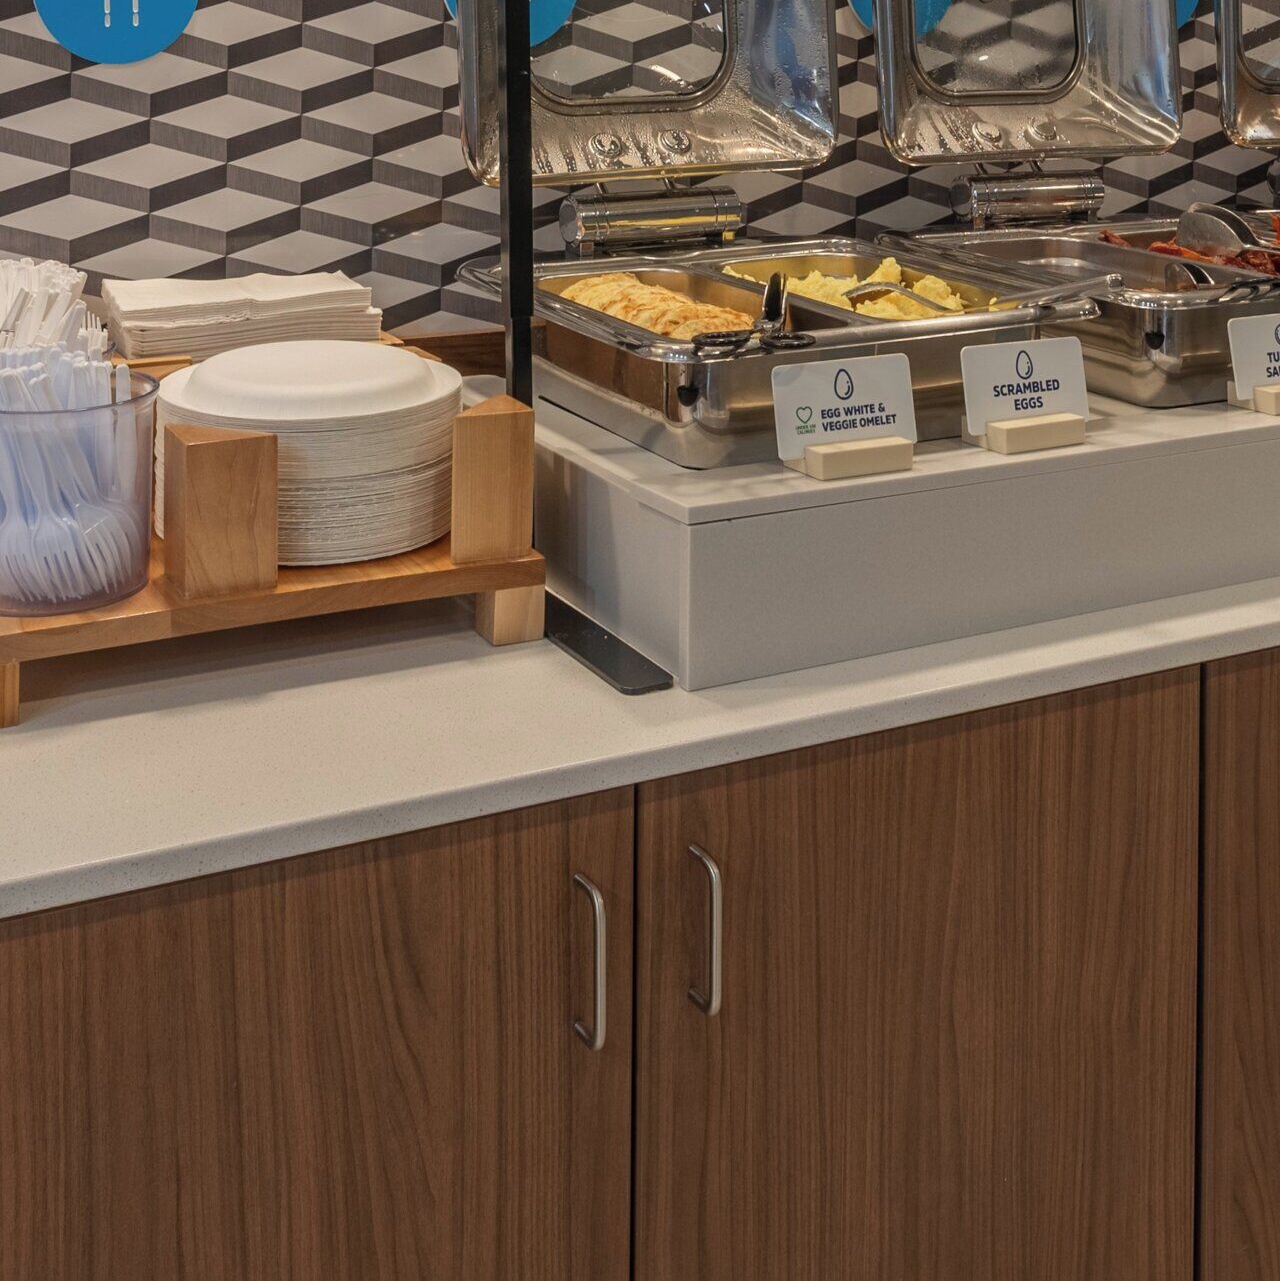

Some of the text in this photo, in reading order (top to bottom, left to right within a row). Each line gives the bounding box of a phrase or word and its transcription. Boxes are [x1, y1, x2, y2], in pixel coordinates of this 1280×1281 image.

[993, 379, 1060, 397] SCRAMBLED
[821, 402, 886, 419] EGG WHITE &
[1014, 396, 1044, 411] EGGS
[821, 414, 897, 432] VEGGIE OMELET
